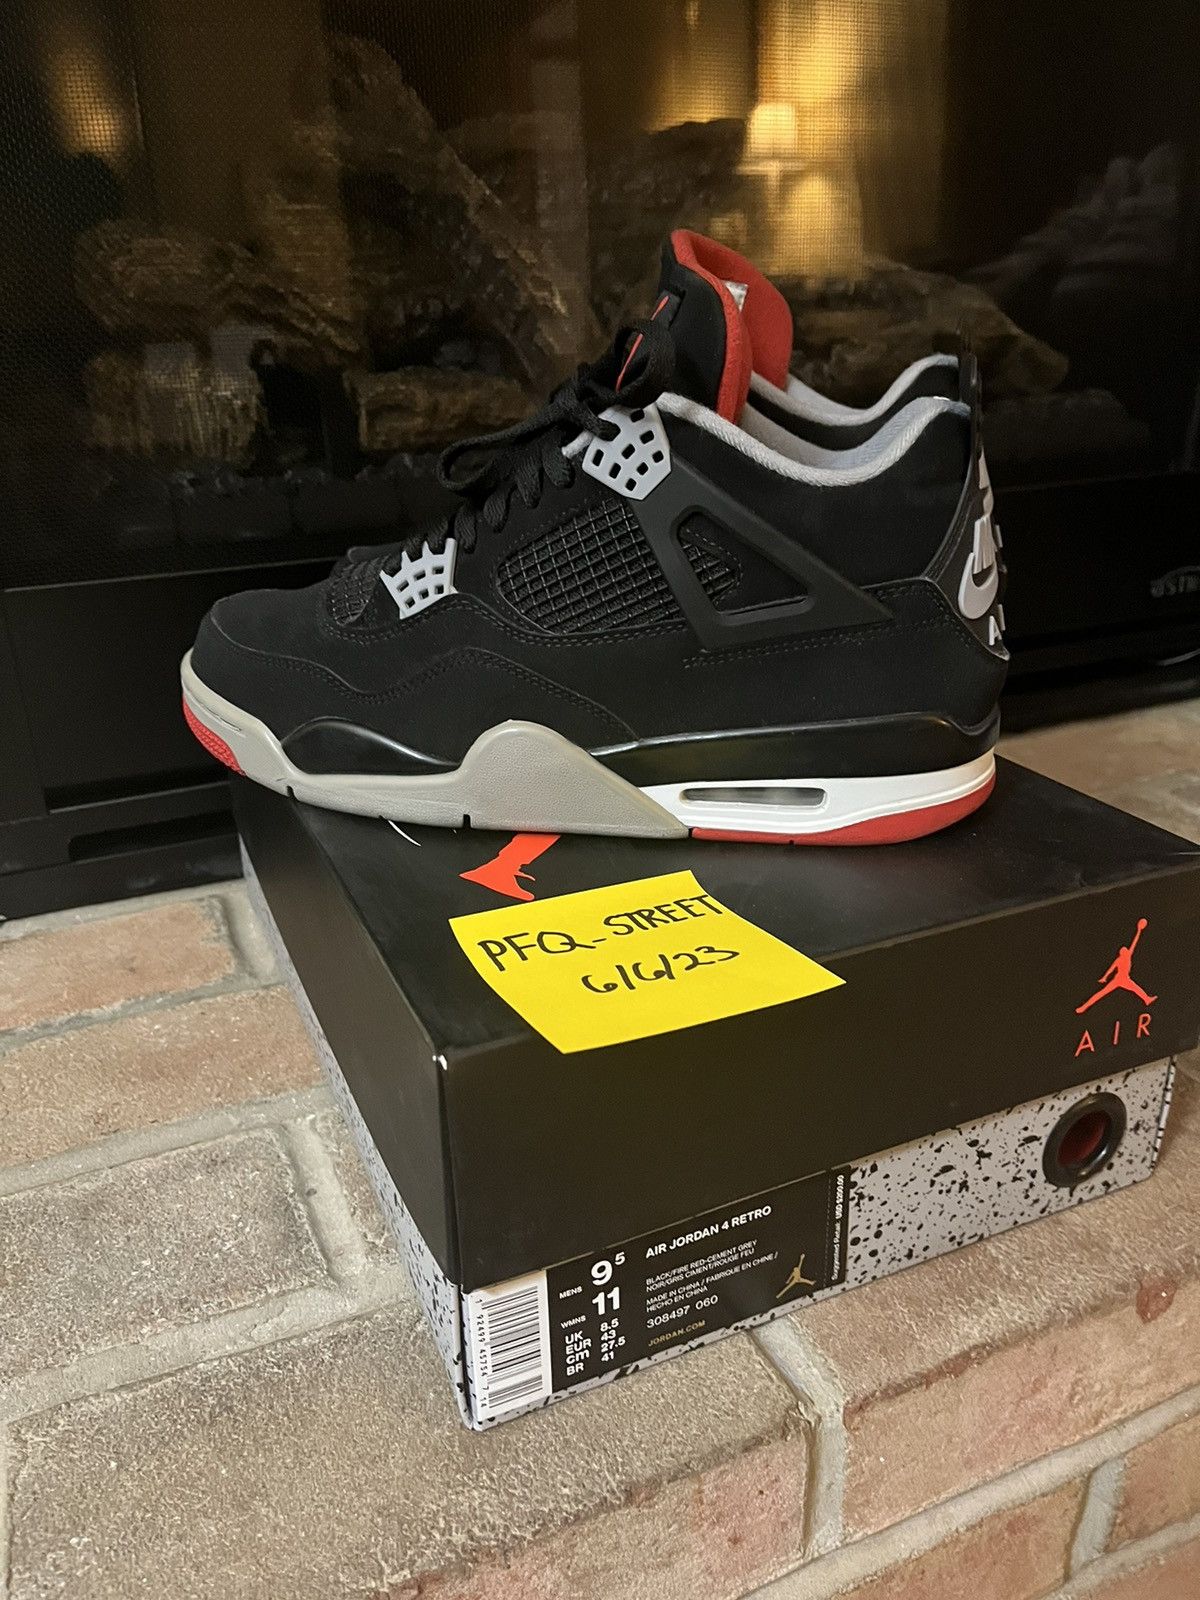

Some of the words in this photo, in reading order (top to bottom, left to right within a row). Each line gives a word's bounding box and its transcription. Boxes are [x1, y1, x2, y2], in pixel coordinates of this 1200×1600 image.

[582, 945, 740, 994] 6/6/23
[1074, 1013, 1152, 1057] AIR
[835, 1204, 843, 1219] USD
[645, 1243, 667, 1259] AIR
[669, 1224, 719, 1250] JORDAN
[721, 1220, 730, 1230] 4
[731, 1205, 772, 1227] RETRO
[559, 1286, 583, 1299] MENS
[591, 1260, 613, 1286] 9
[646, 1265, 690, 1286] BLACK/FIRE
[690, 1247, 737, 1269] RED-CEMENT
[738, 1239, 758, 1252] GREY
[646, 1274, 684, 1292] NOIR/GRIS
[685, 1255, 739, 1278] CIMENT/ROUGE
[740, 1248, 755, 1258] FEU
[646, 1292, 667, 1306] MADE
[668, 1290, 676, 1299] IN
[677, 1281, 701, 1295] CHINA
[706, 1267, 741, 1284] FABRIQUE
[741, 1261, 752, 1271] EN
[752, 1254, 774, 1268] CHINE
[561, 1315, 586, 1329] WMNS
[592, 1287, 620, 1315] 11
[646, 1298, 673, 1313] HECHO
[674, 1294, 685, 1303] EN
[685, 1285, 709, 1299] CHINA
[646, 1305, 690, 1329] 308497
[695, 1295, 719, 1310] 060
[565, 1331, 584, 1344] UK
[600, 1318, 619, 1332] 8.5
[566, 1338, 592, 1355] EUR
[600, 1330, 616, 1341] 43
[601, 1336, 626, 1353] 27.5
[648, 1320, 706, 1347] JORDAN.COM
[567, 1363, 584, 1376] BR
[601, 1352, 614, 1362] 41
